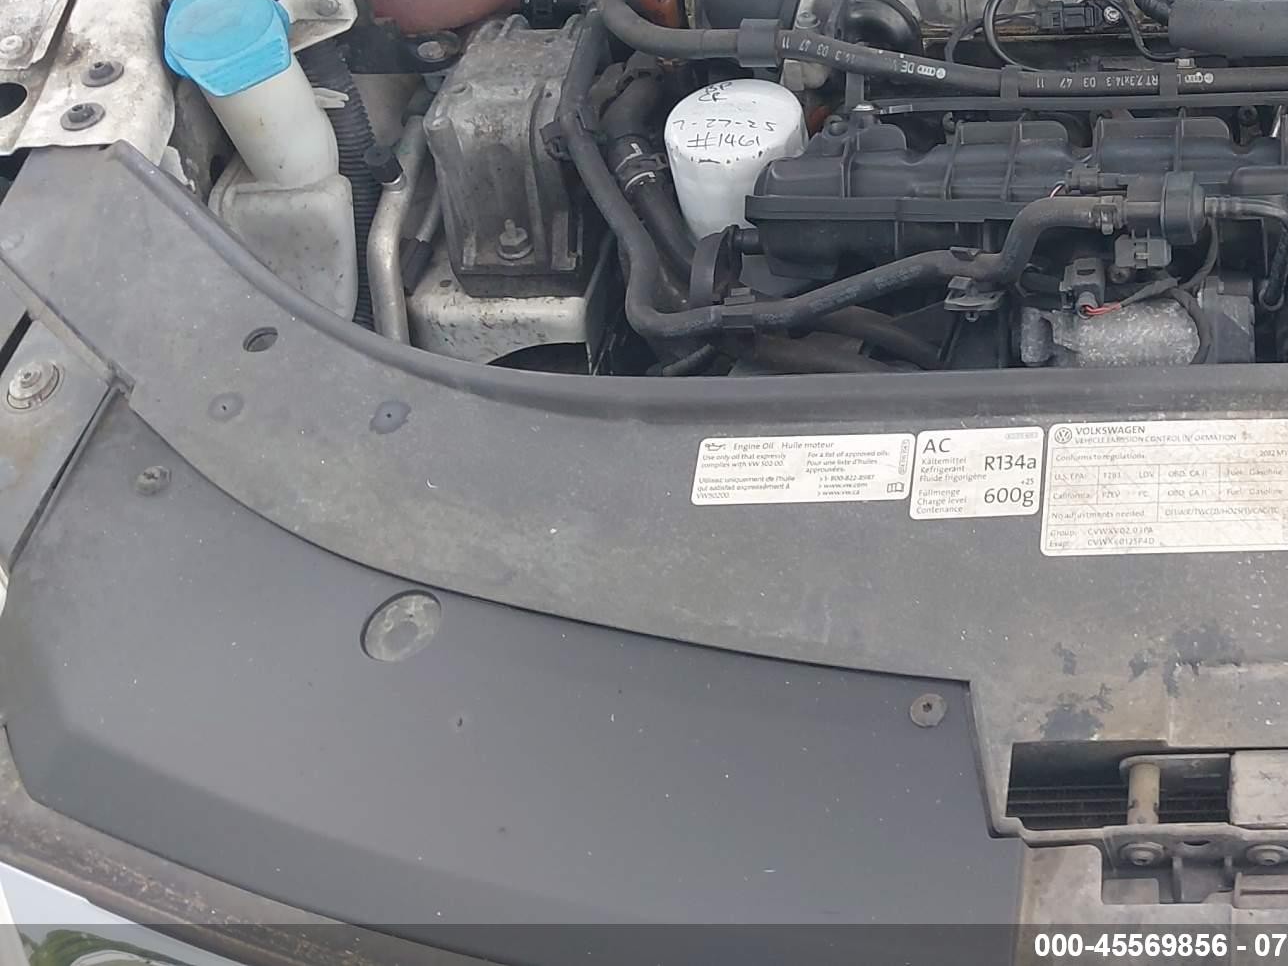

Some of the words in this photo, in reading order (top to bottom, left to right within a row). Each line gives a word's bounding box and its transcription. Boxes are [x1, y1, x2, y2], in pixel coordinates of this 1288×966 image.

[687, 132, 760, 150] #1461
[1075, 425, 1146, 435] VOLKSWAGEN
[733, 442, 760, 452] Engine
[762, 442, 774, 450] Oil
[804, 441, 834, 449] moteur
[923, 438, 951, 454] AC
[984, 454, 1037, 471] R134a
[983, 487, 1035, 508] 600g
